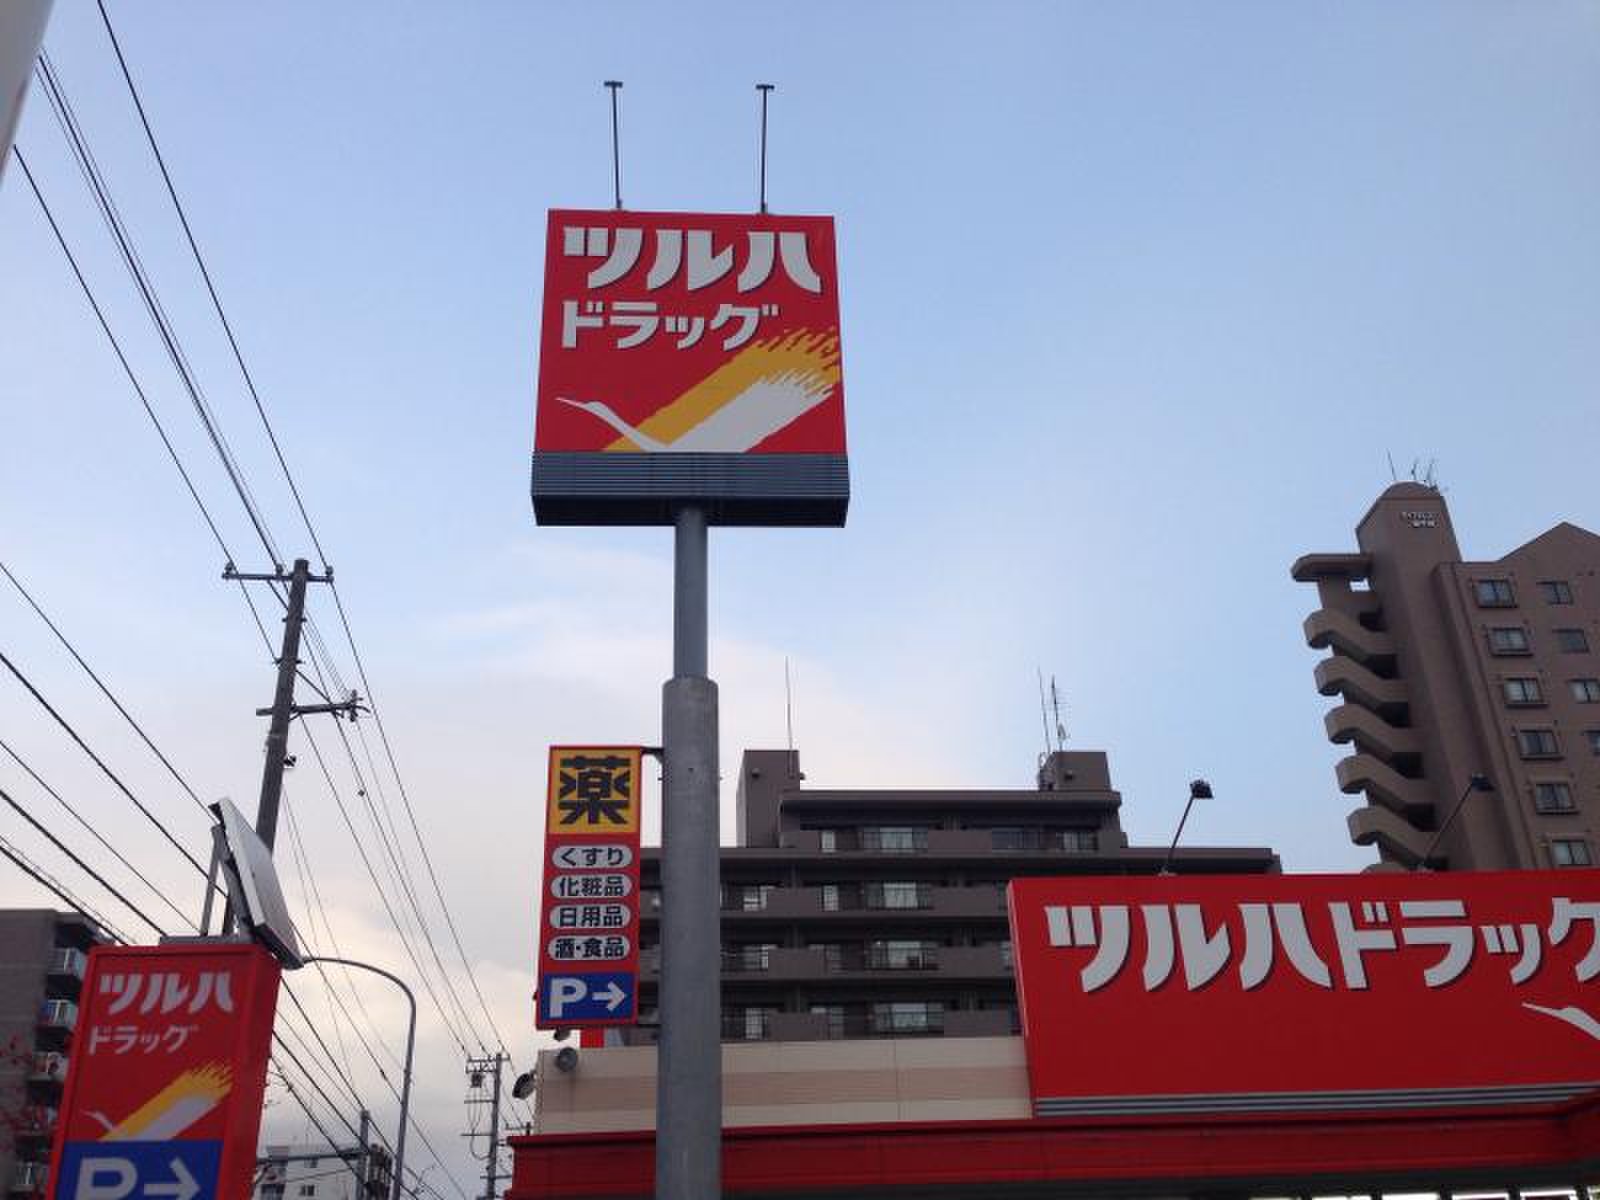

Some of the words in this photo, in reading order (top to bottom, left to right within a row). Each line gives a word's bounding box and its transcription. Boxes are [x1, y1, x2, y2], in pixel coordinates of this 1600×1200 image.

[563, 226, 822, 294] ツルハ
[562, 300, 780, 351] ドラッグ
[558, 755, 631, 825] 薬
[560, 848, 624, 866] くすり
[559, 876, 624, 896] 化粧品
[559, 906, 623, 926] 日用品
[99, 972, 235, 1015] ツルハ
[548, 977, 588, 1019] P
[88, 1025, 199, 1055] ドラッグ
[74, 1157, 138, 1200] P
